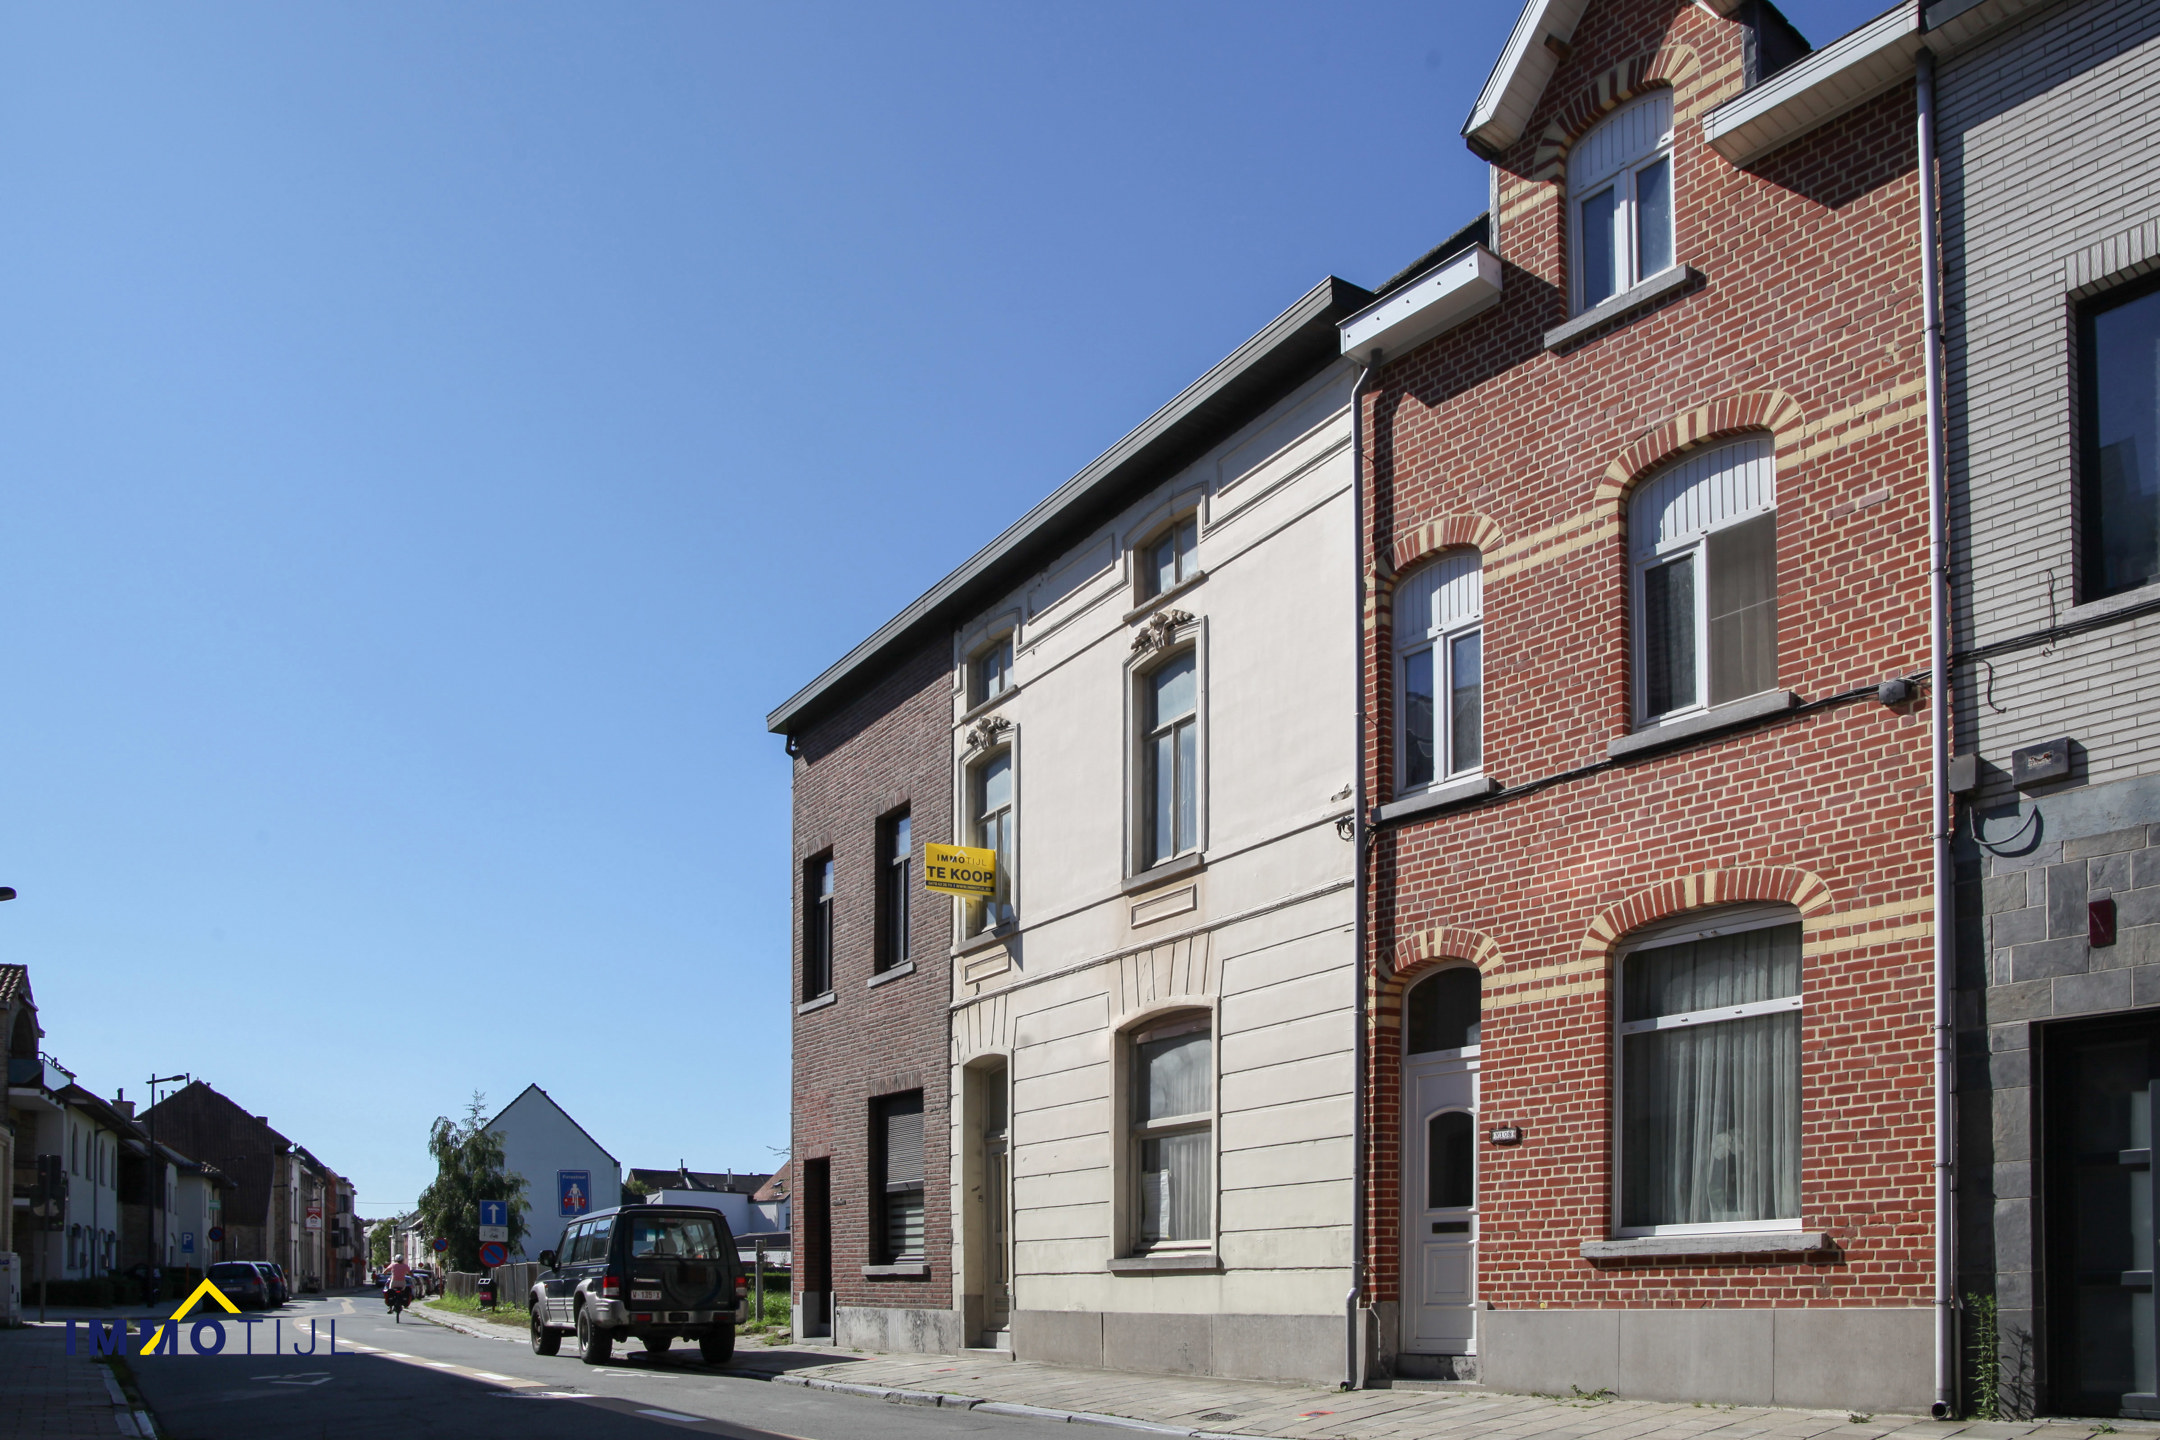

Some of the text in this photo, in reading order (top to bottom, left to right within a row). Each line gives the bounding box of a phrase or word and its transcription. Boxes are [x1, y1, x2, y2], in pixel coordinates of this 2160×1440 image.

[937, 854, 987, 866] IMMOTIJL
[926, 865, 993, 883] TE KOOP
[183, 1233, 192, 1245] P
